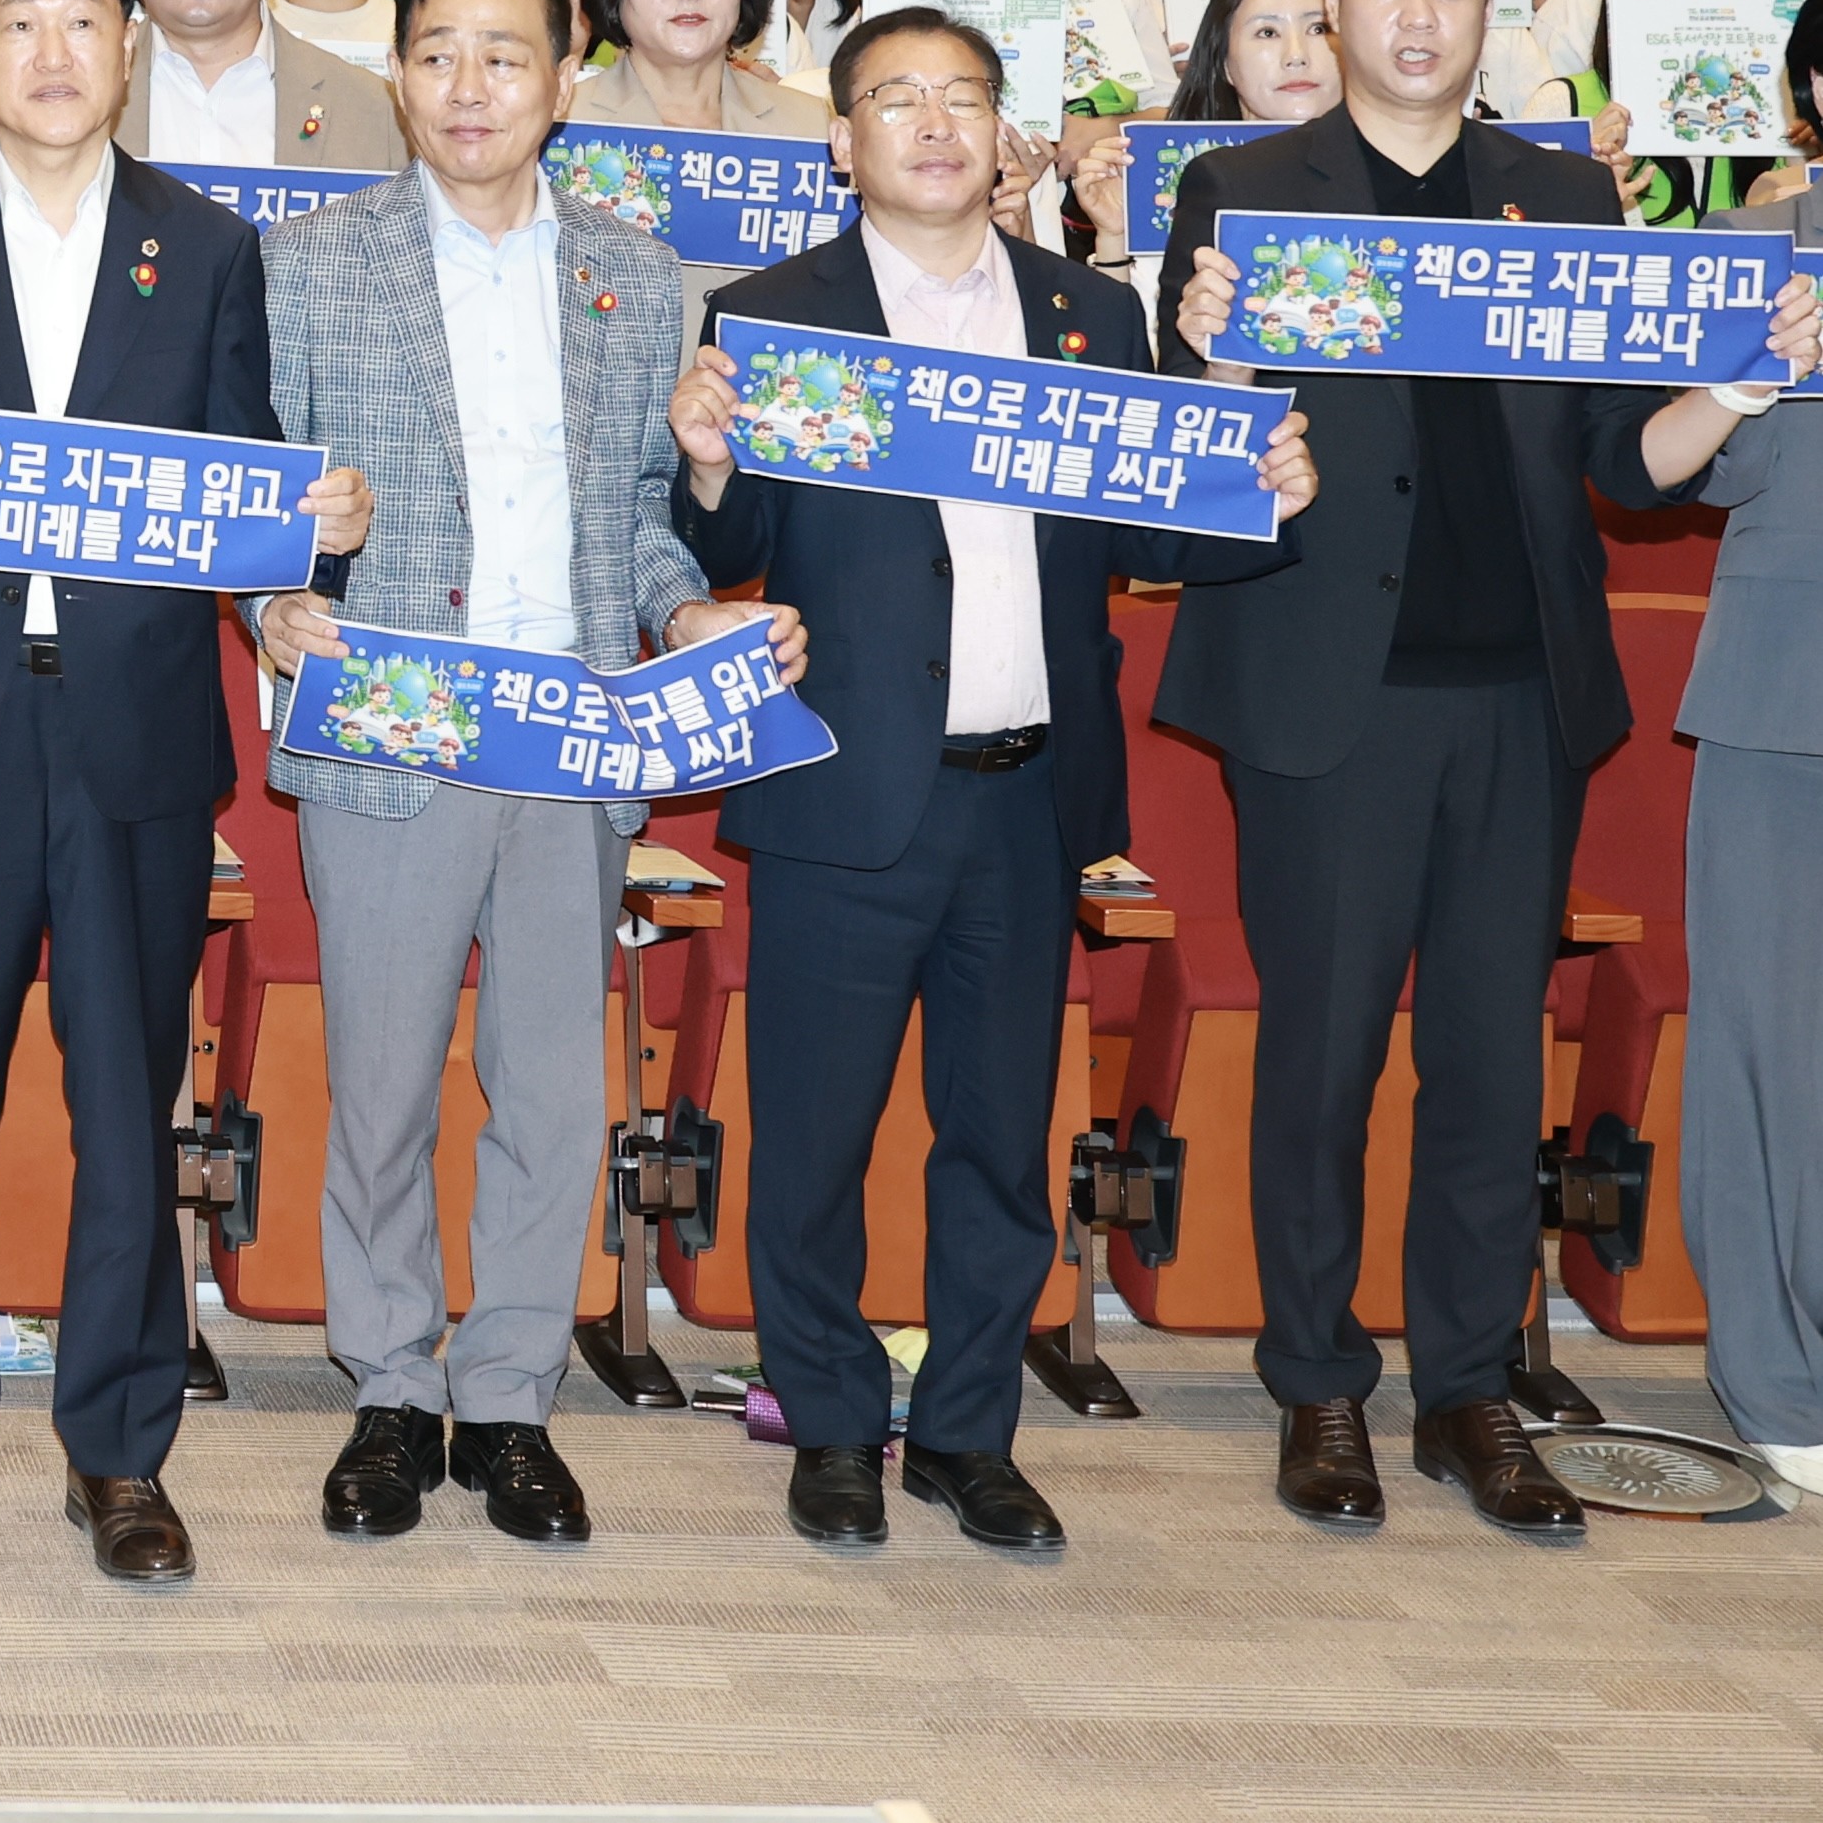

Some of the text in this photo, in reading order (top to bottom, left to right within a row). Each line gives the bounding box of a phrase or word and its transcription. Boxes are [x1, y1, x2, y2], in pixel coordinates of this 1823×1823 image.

[1646, 33, 1671, 45] ESG
[679, 150, 859, 211] 책으로 지구
[739, 207, 841, 256] 미래를
[1414, 243, 1774, 313] 책으로 지구를 읽고,
[1485, 305, 1704, 367] 미래를 쓰다
[906, 366, 1258, 471] 책으로 지구를 읽고,
[57, 447, 187, 517] 지구를
[201, 462, 291, 532] 읽고,
[971, 429, 1192, 510] 미래를 쓰다
[133, 514, 219, 573] 쓰다
[492, 662, 616, 734] 책으로
[558, 711, 760, 791] 미래를 쓰다
